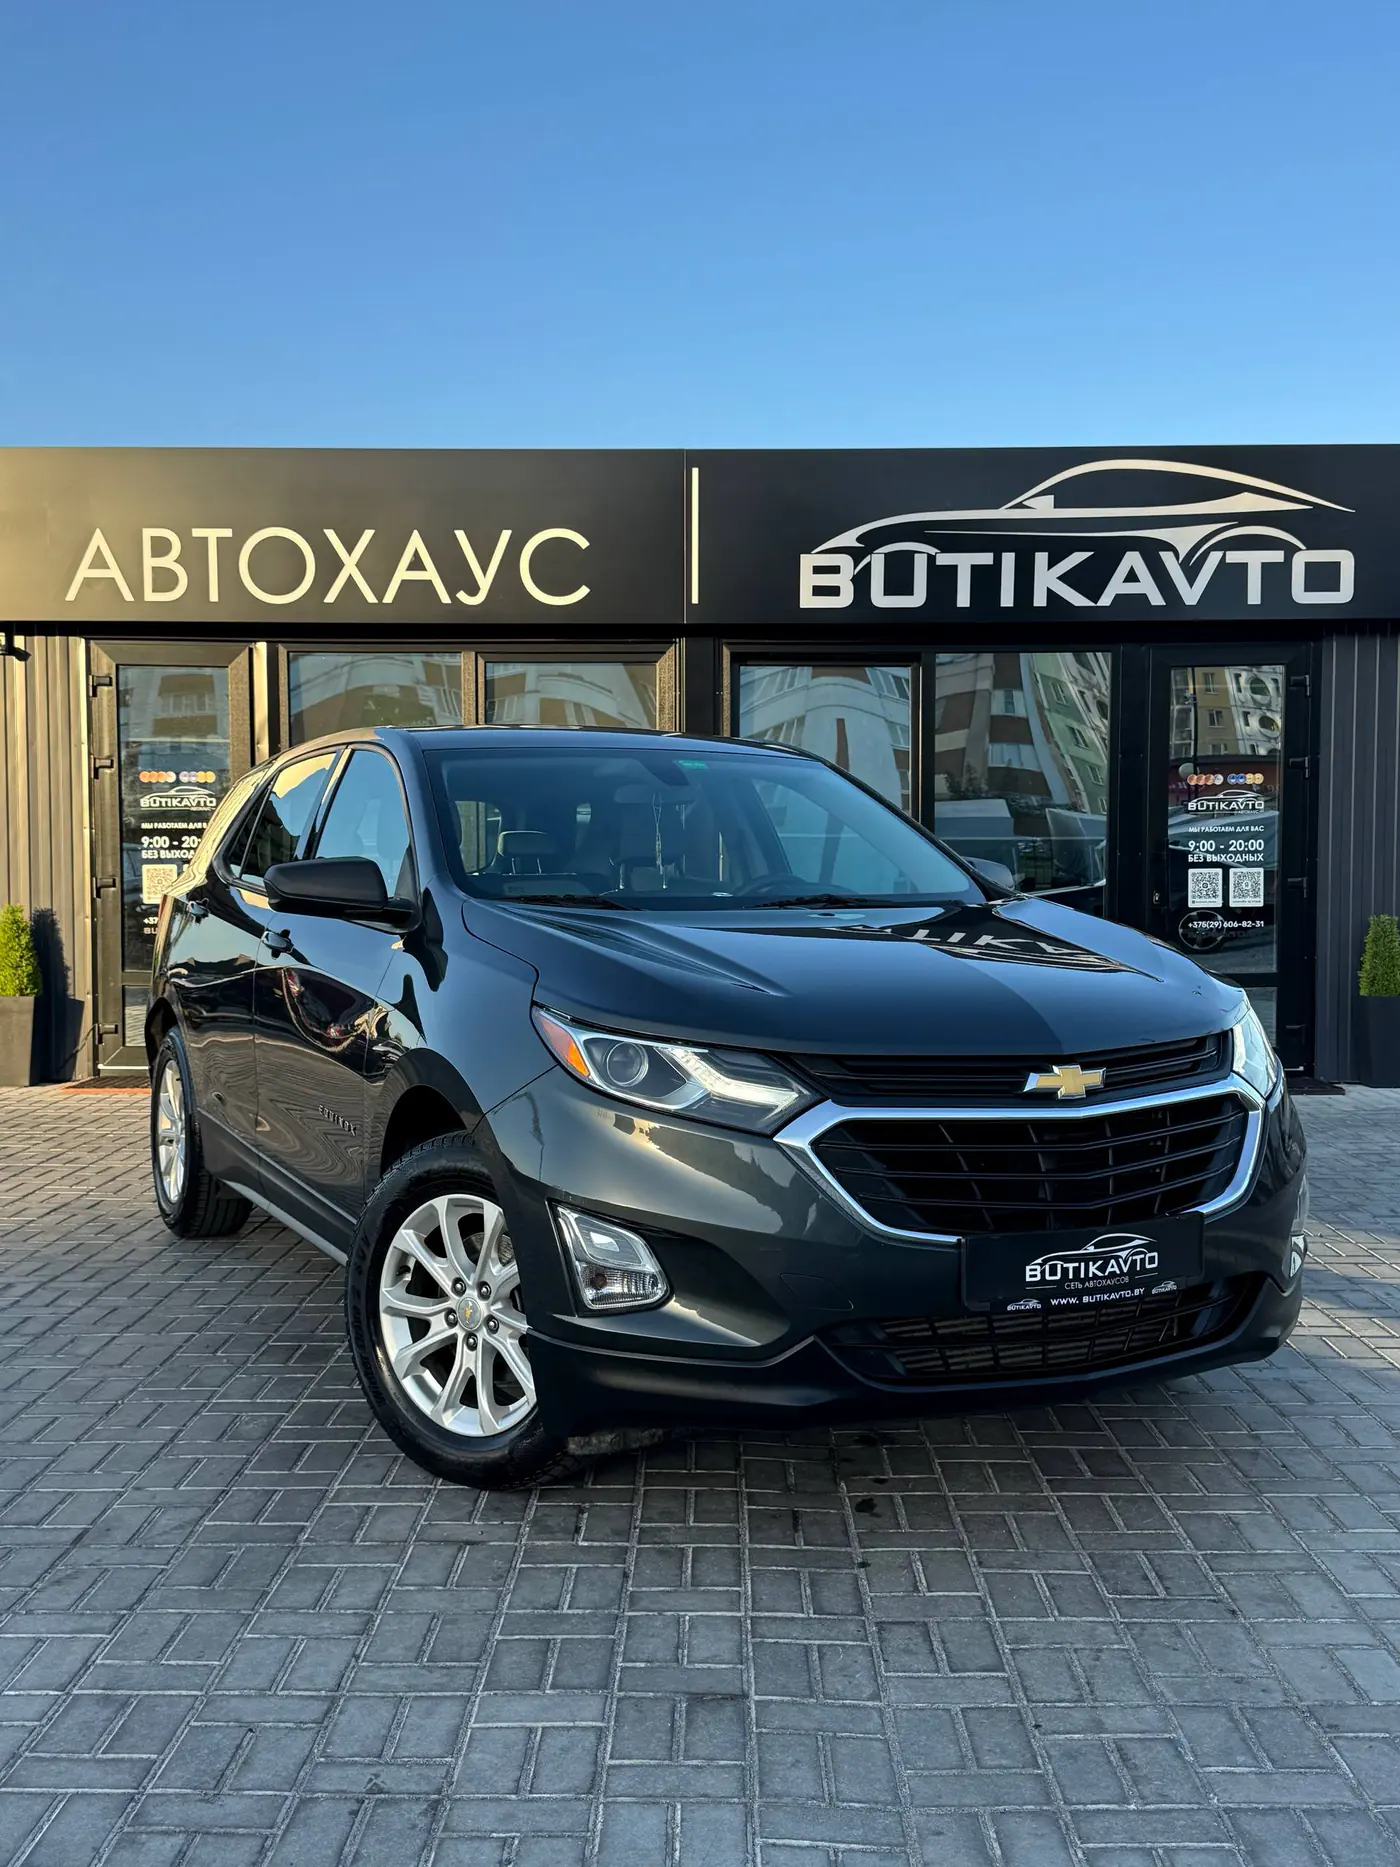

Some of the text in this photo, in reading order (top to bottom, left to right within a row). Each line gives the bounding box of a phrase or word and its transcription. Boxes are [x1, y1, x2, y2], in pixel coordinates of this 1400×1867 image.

[65, 526, 591, 607] АВТОХАУС
[799, 547, 1356, 609] BUTIKAVTO
[140, 797, 217, 808] BUTIKAVTO
[1187, 800, 1265, 811] BUTIKAVTO
[141, 836, 170, 848] 9:00
[1188, 840, 1216, 852] 9:00
[1228, 839, 1265, 851] 20:00
[141, 850, 159, 859] БЕЗ
[1188, 853, 1264, 863] БЕЗ ВЫХОДНЫХ
[1188, 920, 1265, 929] +375(29) 606-82-31
[1025, 1251, 1159, 1282] BUTIKAVTO
[1064, 1276, 1129, 1290] СЕТЬ АВТОХАУСОВ
[1082, 1287, 1145, 1303] BUTIKAVTO.BY
[1006, 1303, 1042, 1311] BUTIKAVTO
